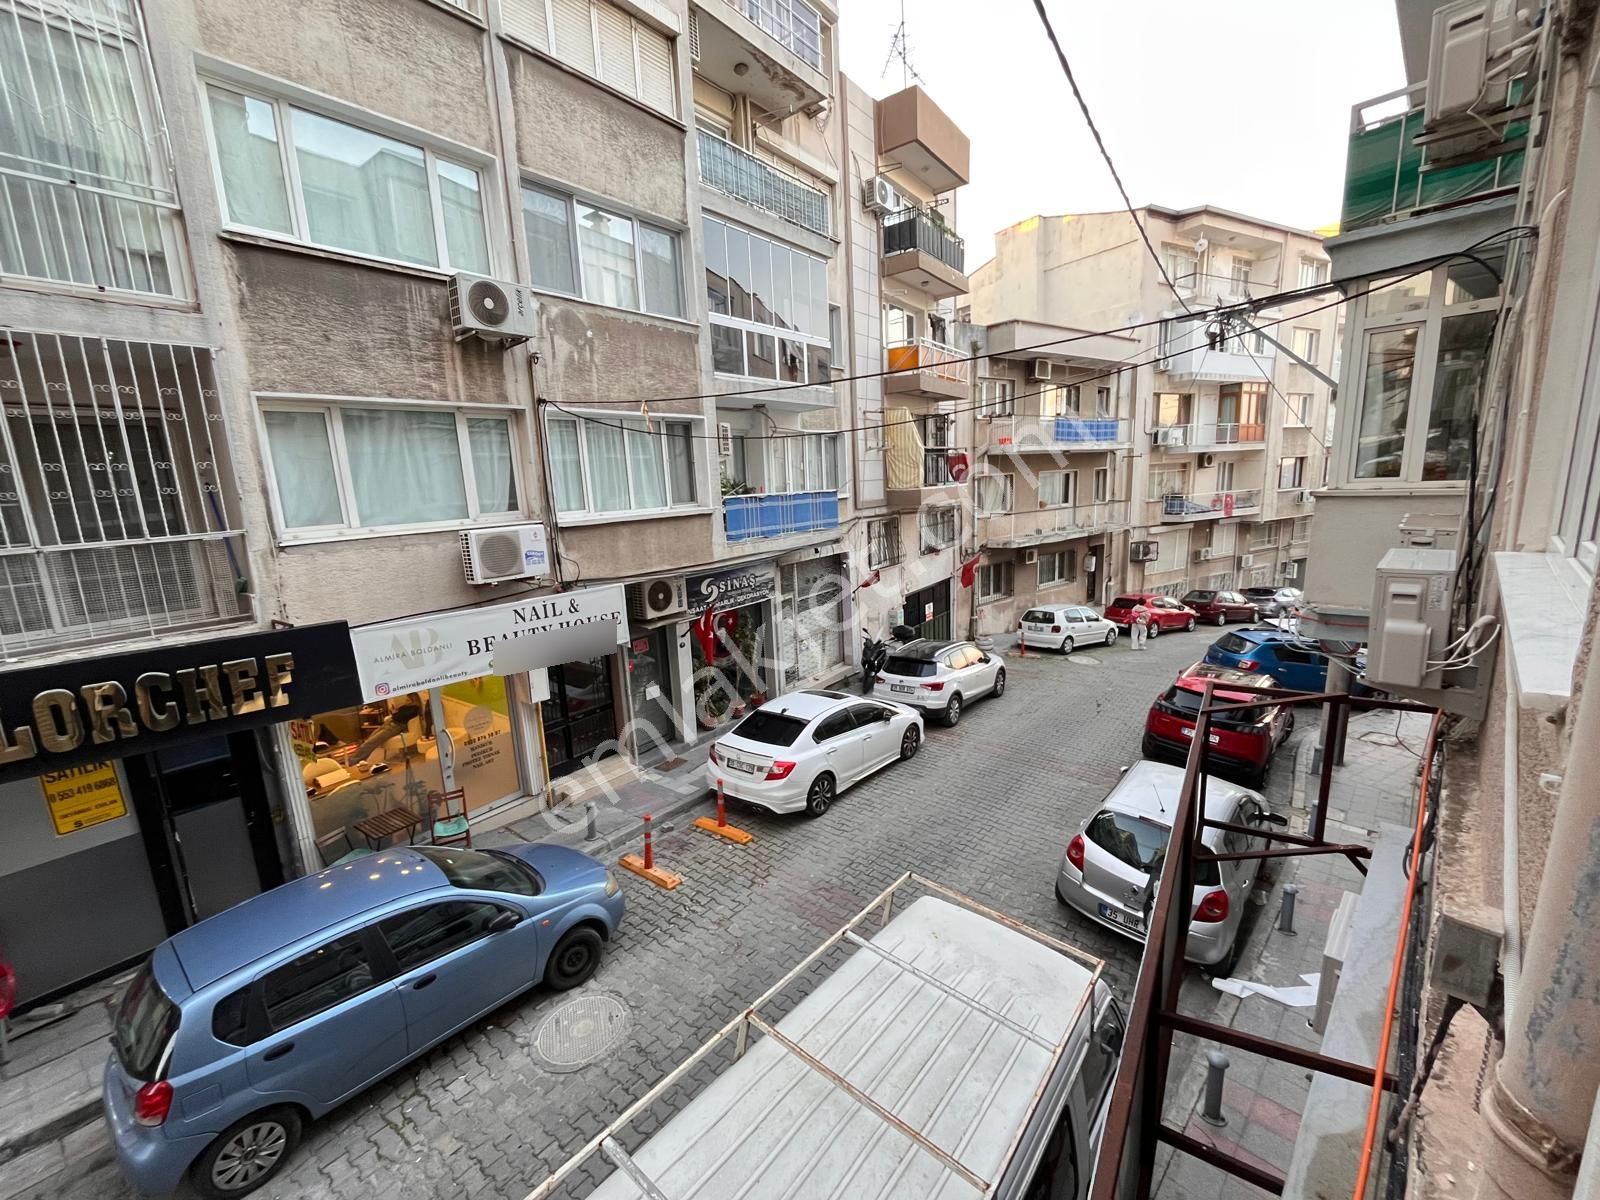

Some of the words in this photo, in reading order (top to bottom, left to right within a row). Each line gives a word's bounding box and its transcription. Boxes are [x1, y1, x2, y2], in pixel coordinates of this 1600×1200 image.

[513, 601, 562, 625] NAİL
[568, 598, 580, 614] &
[1107, 909, 1118, 919] 35
